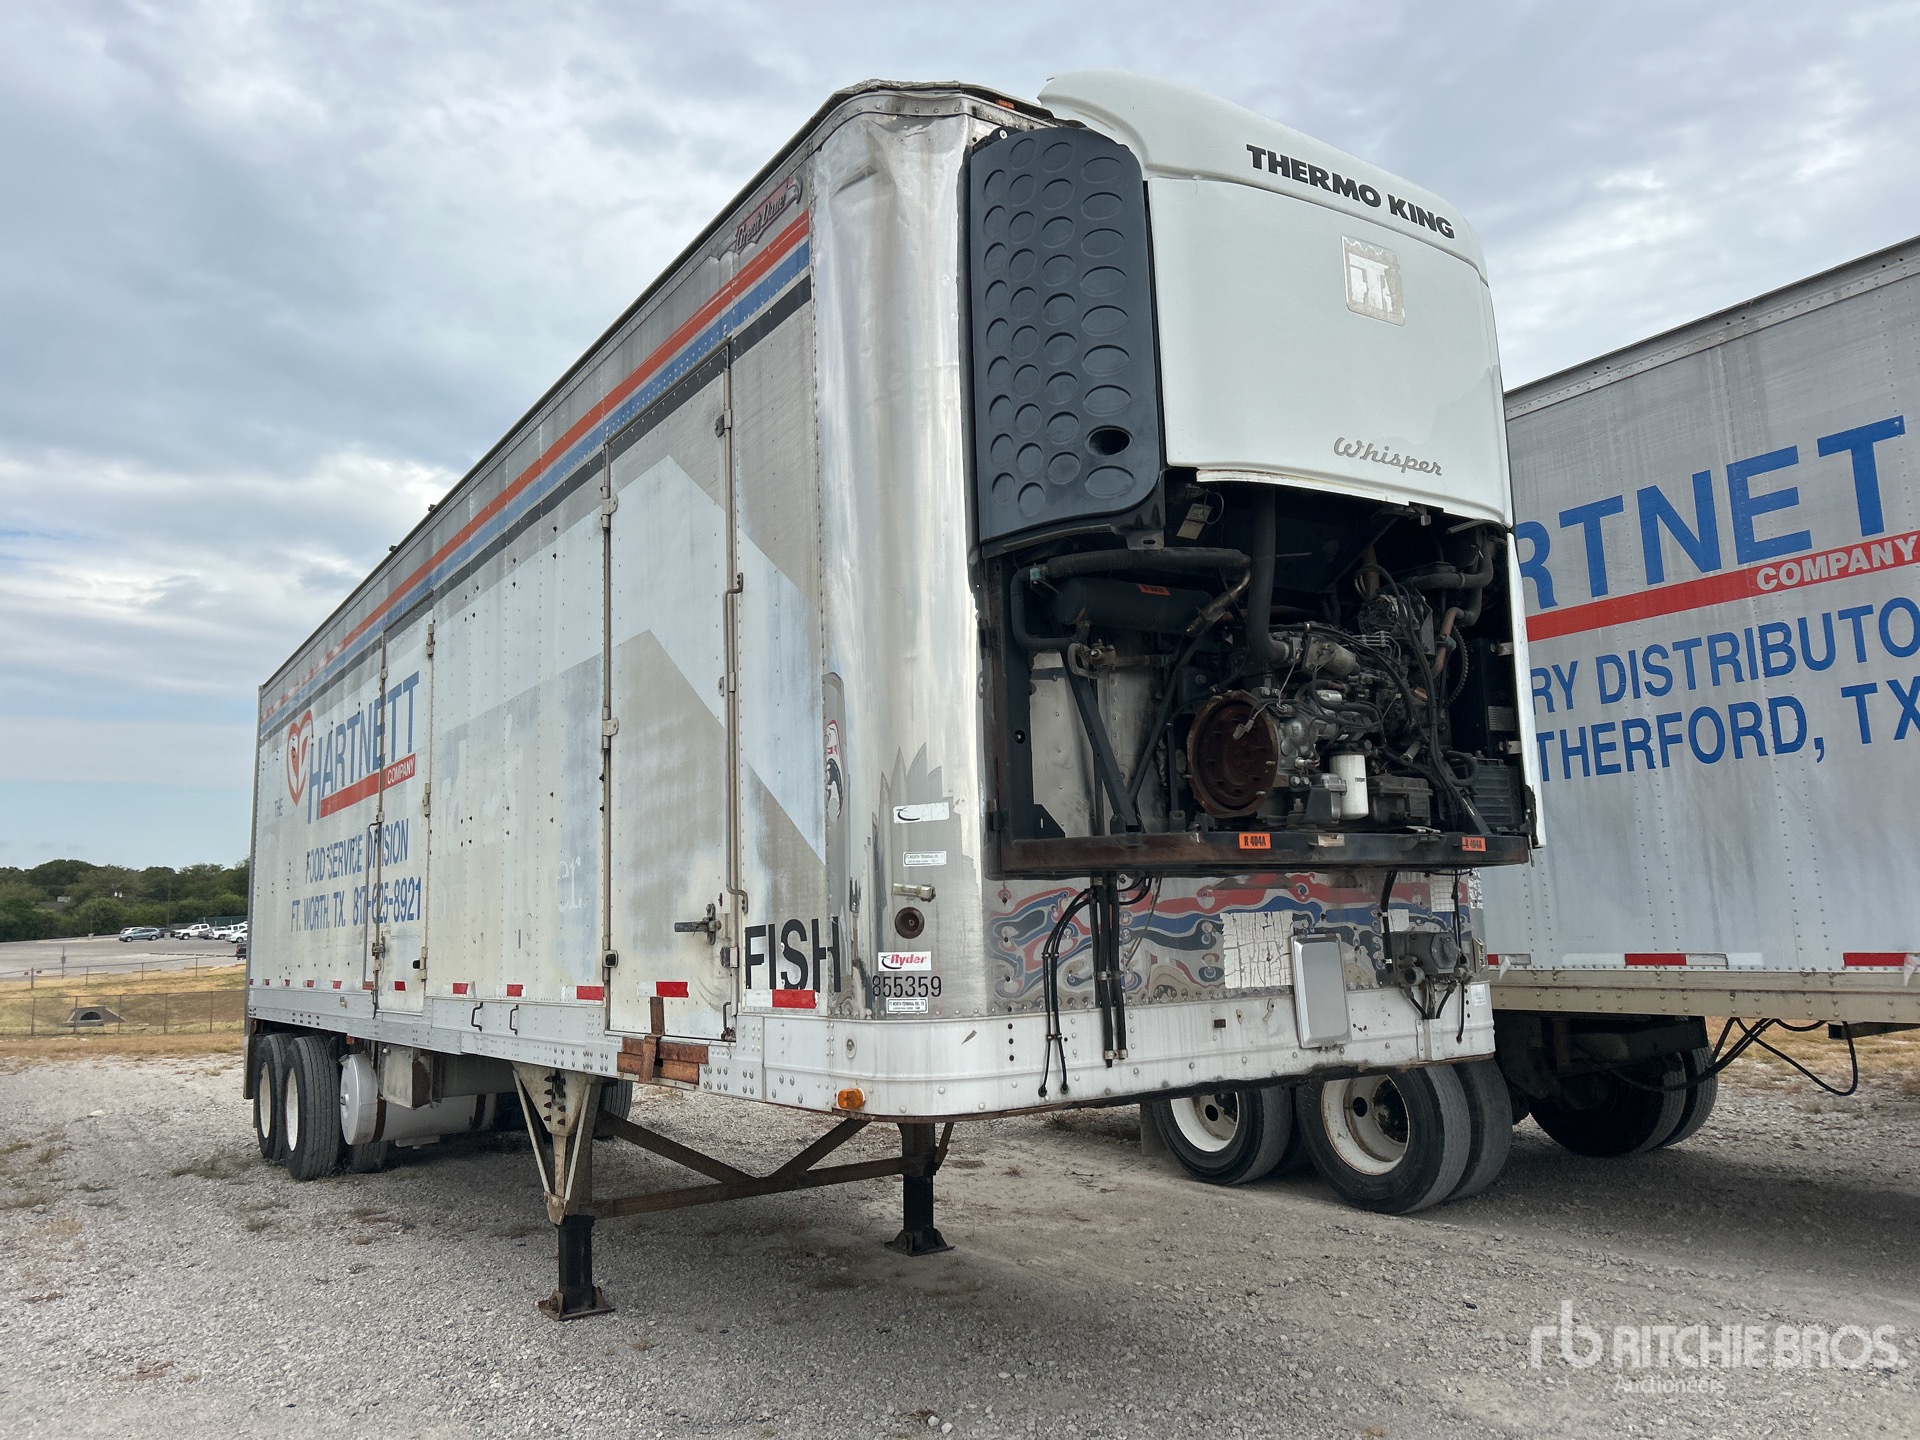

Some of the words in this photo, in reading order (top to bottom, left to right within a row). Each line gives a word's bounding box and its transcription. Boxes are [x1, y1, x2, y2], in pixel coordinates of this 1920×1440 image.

[1246, 144, 1382, 208] THERMO
[1387, 194, 1455, 239] KING
[1333, 436, 1443, 477] Whisper
[1756, 535, 1918, 591] COMPANY
[1595, 597, 1920, 705] DISTRIBUTO
[307, 671, 420, 824] HARTNETT
[387, 757, 416, 785] COMPANY
[305, 847, 326, 884] FOOD
[327, 834, 363, 881] SERVICE
[1244, 835, 1249, 847] R
[1250, 835, 1267, 847] 404A
[745, 916, 842, 994] FISH
[890, 953, 926, 966] Ryder
[872, 975, 942, 998] 855359
